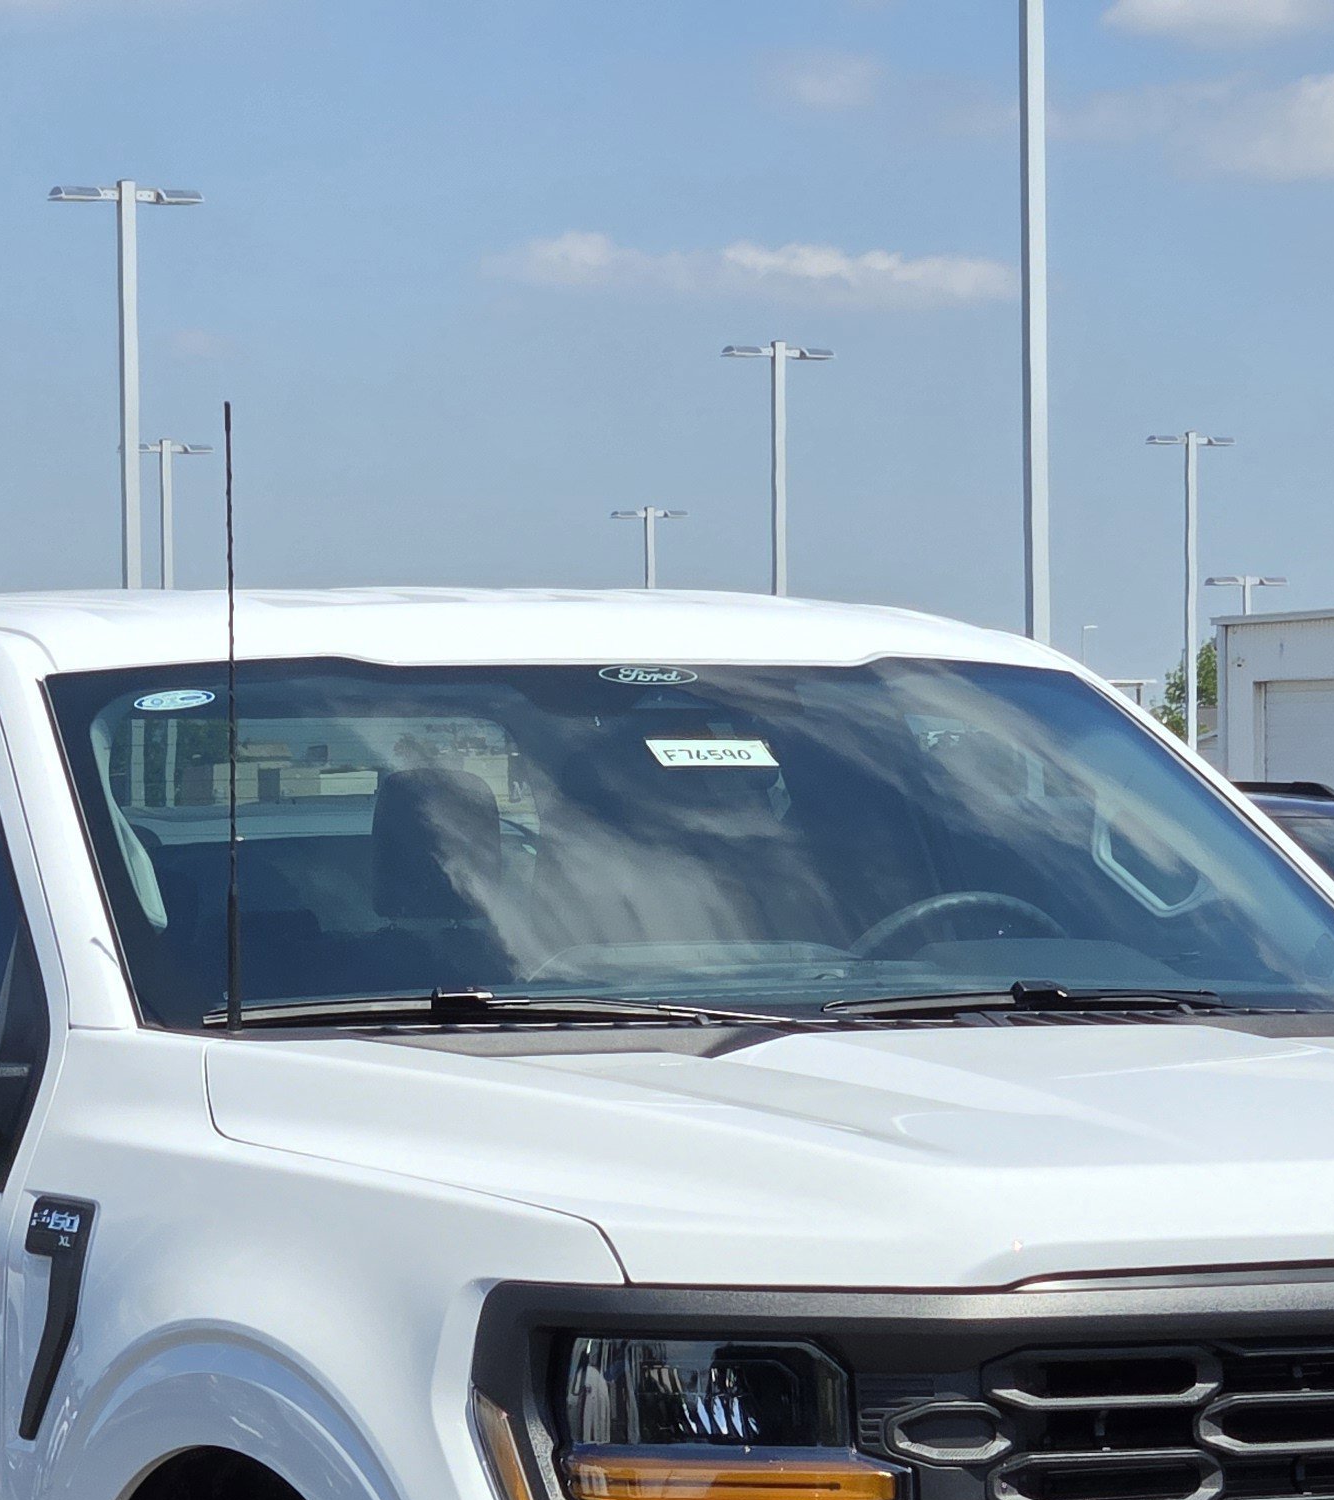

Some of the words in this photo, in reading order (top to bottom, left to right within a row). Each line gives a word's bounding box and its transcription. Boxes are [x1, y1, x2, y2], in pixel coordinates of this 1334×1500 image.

[618, 667, 681, 682] Ford
[663, 749, 752, 761] F76590
[58, 1235, 71, 1247] XL
